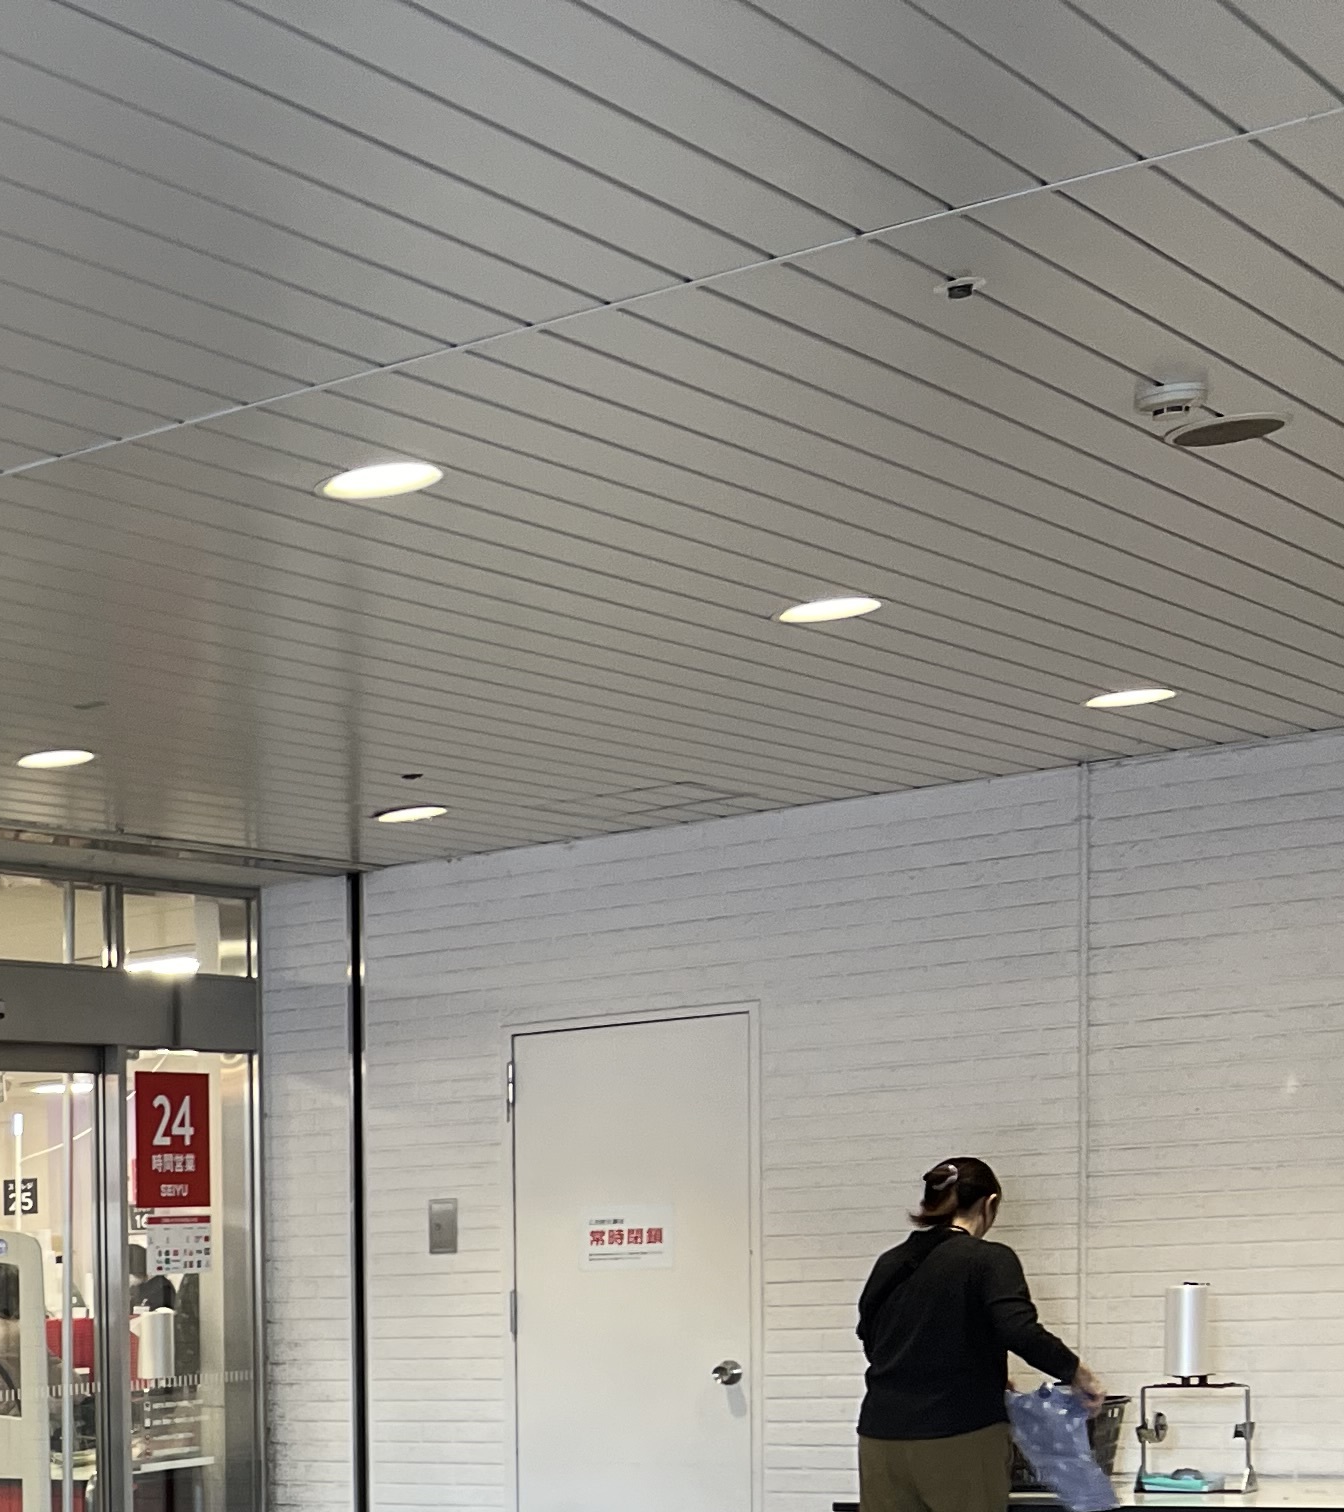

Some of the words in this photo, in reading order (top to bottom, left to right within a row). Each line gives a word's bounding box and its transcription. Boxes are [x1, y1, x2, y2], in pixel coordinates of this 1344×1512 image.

[152, 1094, 195, 1146] 24
[152, 1154, 196, 1172] 時間営業
[160, 1184, 189, 1197] SEIYU
[8, 1192, 34, 1212] 25
